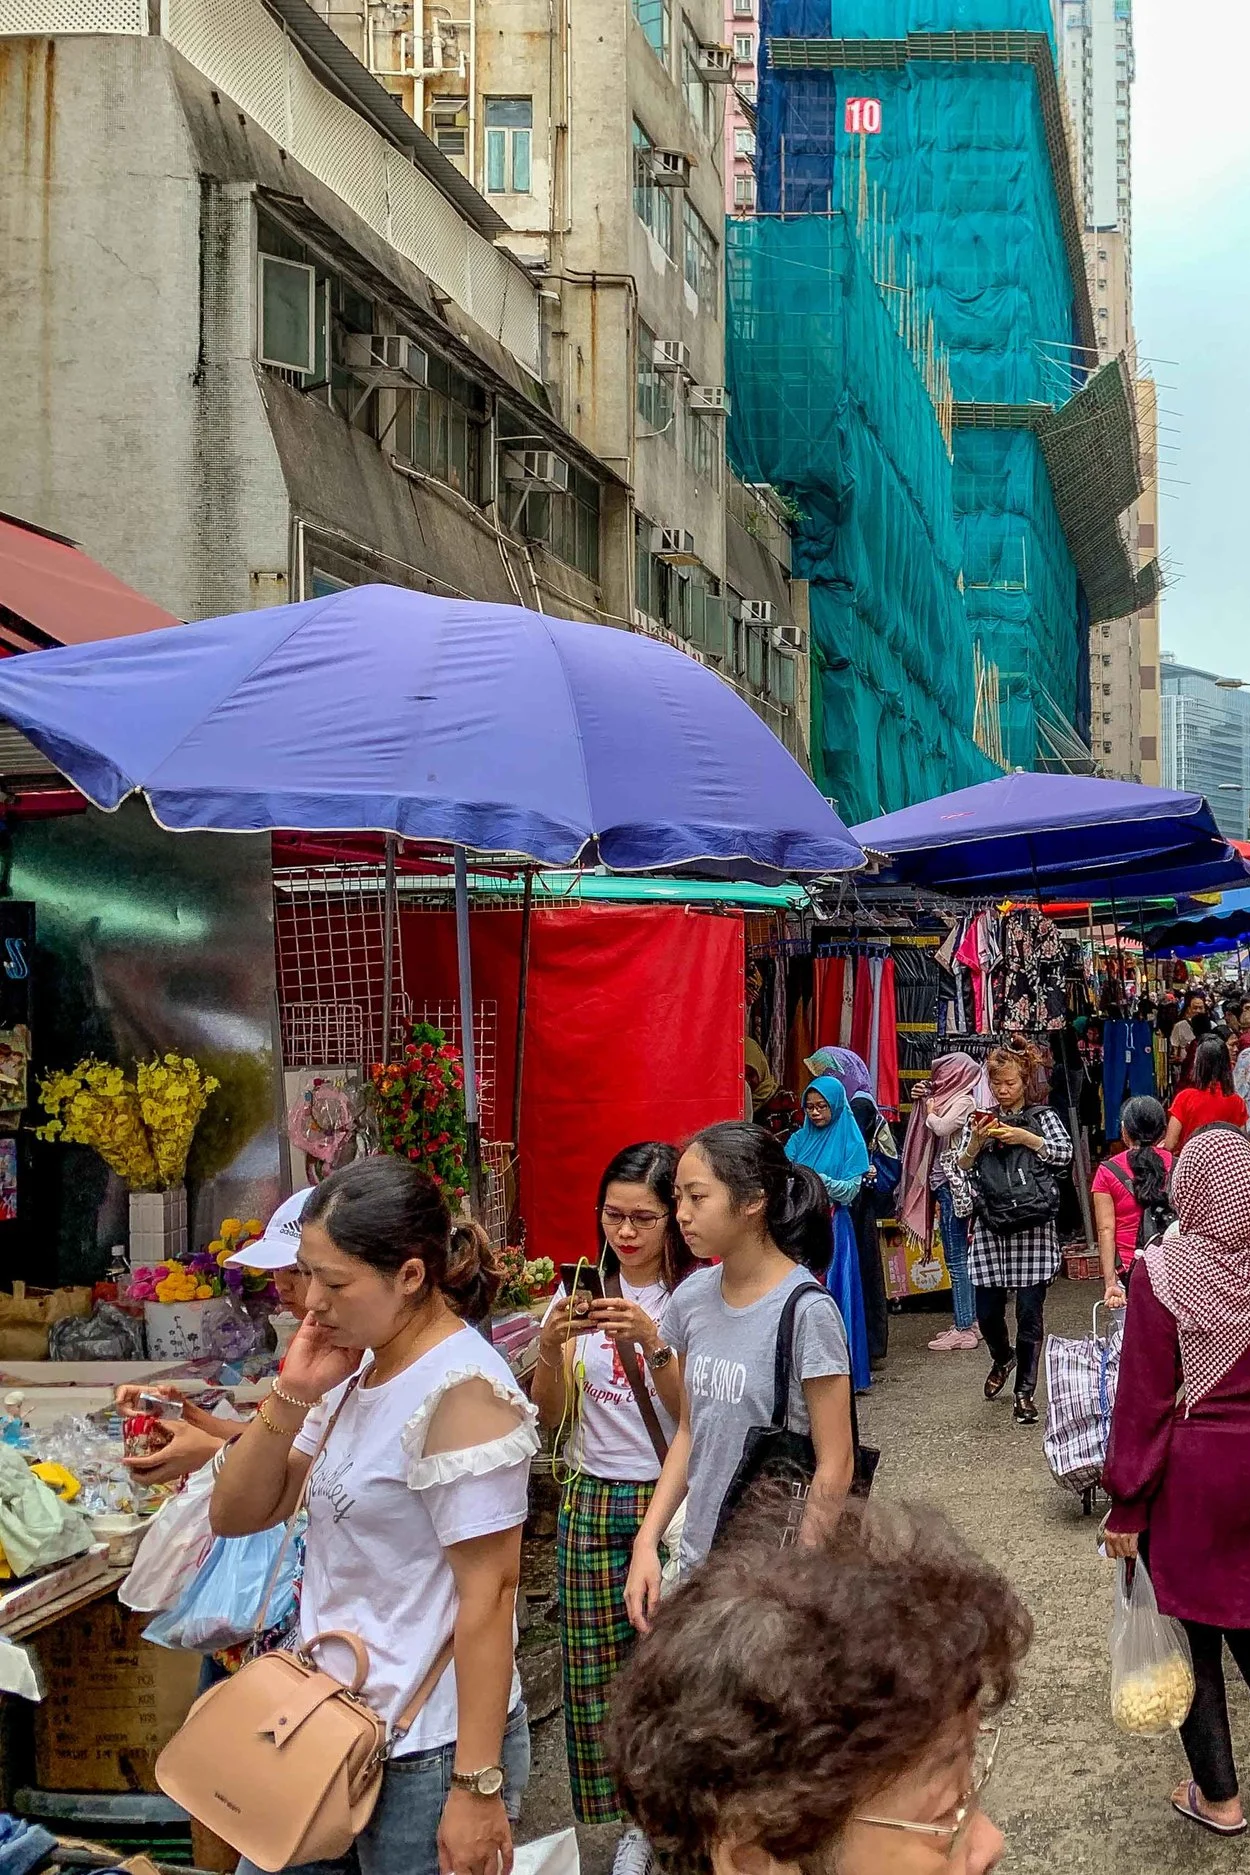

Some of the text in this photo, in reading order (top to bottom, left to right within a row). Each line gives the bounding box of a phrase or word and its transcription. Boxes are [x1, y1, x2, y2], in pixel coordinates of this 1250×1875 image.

[847, 99, 881, 131] 10
[583, 1380, 623, 1406] Happy
[693, 1355, 747, 1404] BE KIND
